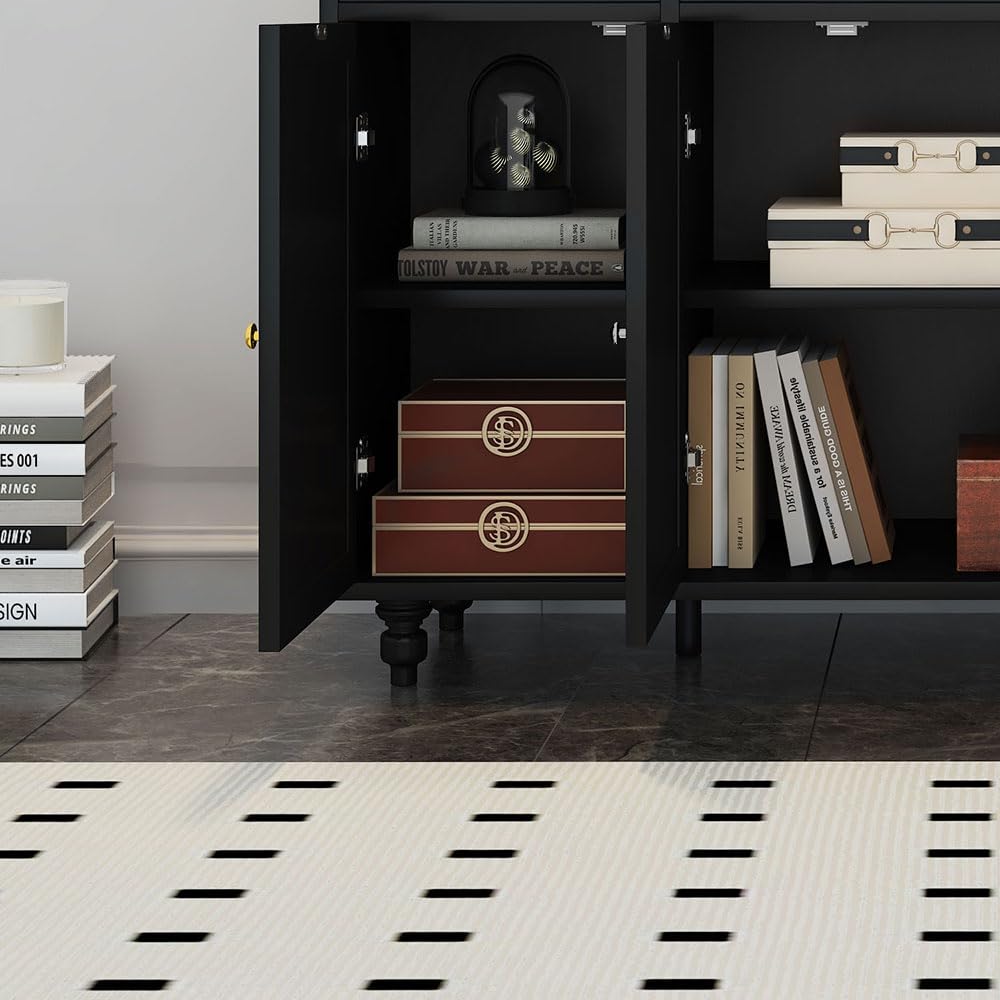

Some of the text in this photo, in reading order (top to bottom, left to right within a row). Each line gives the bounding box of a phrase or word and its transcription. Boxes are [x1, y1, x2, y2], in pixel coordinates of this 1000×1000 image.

[455, 260, 511, 276] WAR
[530, 260, 604, 276] PEACE
[0, 424, 36, 435] RINGS
[0, 453, 38, 468] ES 001
[0, 483, 37, 494] RINGS
[0, 529, 32, 544] OINTS
[15, 555, 37, 566] air
